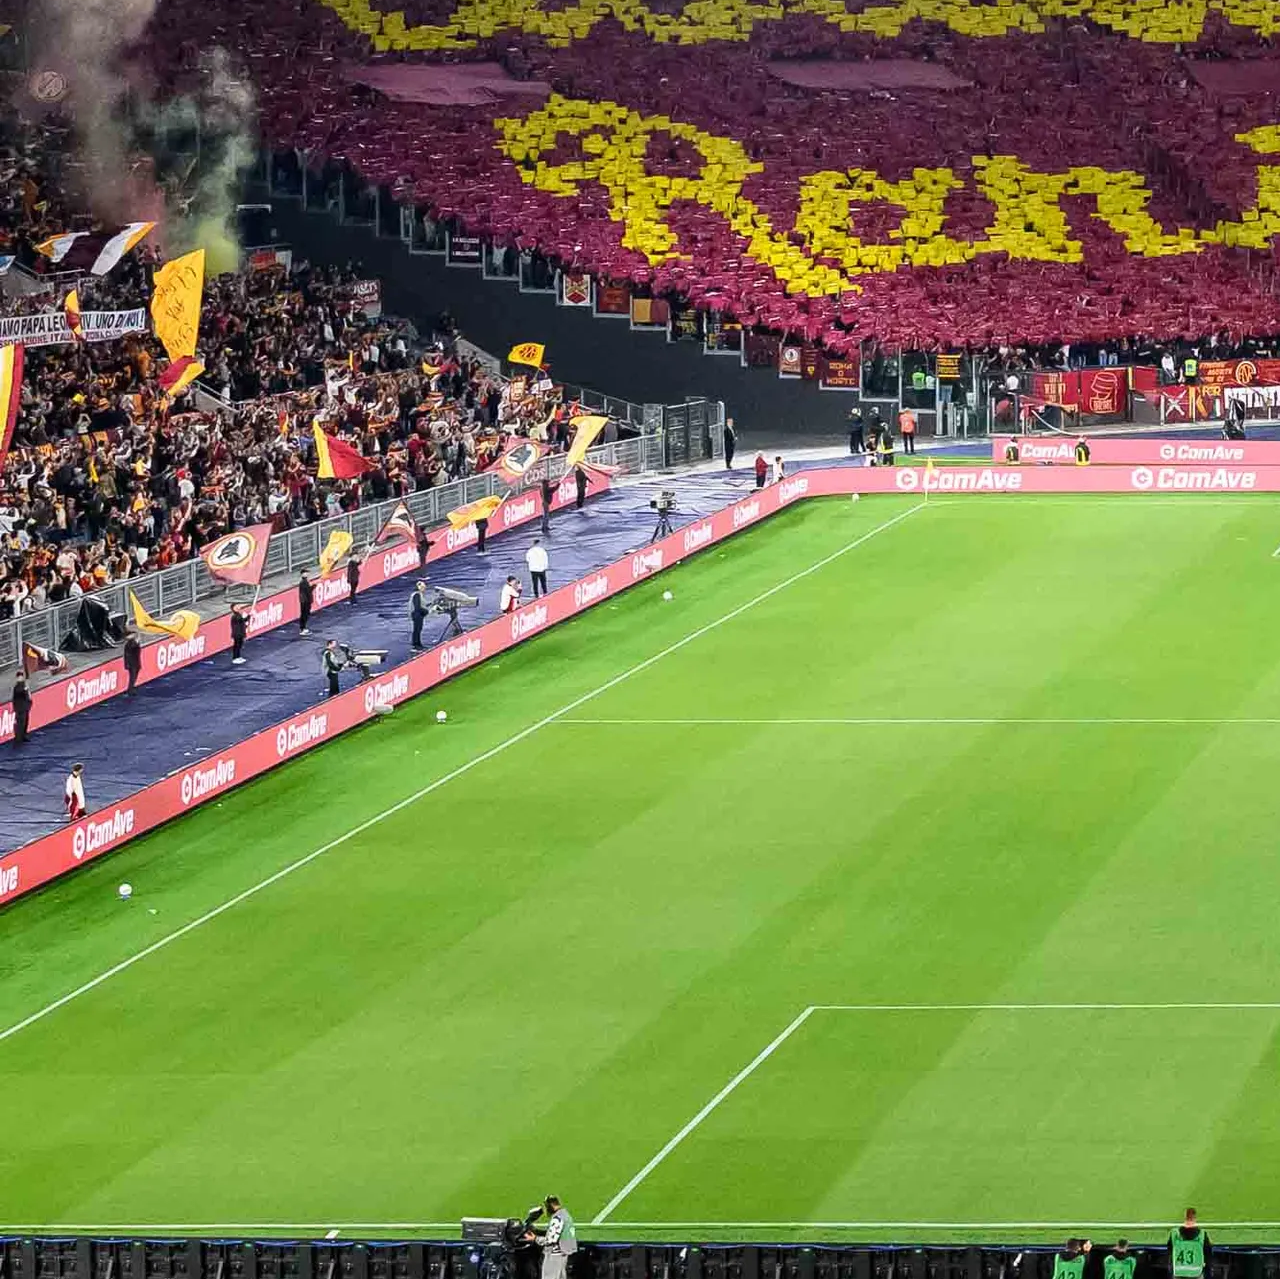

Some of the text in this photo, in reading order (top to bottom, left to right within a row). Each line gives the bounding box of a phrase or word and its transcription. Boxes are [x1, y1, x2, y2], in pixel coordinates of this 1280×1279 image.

[1178, 444, 1244, 461] ComAve
[922, 470, 1023, 490] ComAve
[1157, 469, 1255, 489] ComAve
[167, 635, 206, 667] ComAve
[450, 638, 481, 670] ComAve
[77, 672, 117, 703] ComAve
[286, 713, 327, 751] ComAve
[193, 759, 235, 799] ComAve
[86, 809, 134, 851] ComAve
[1176, 1250, 1194, 1265] 43
